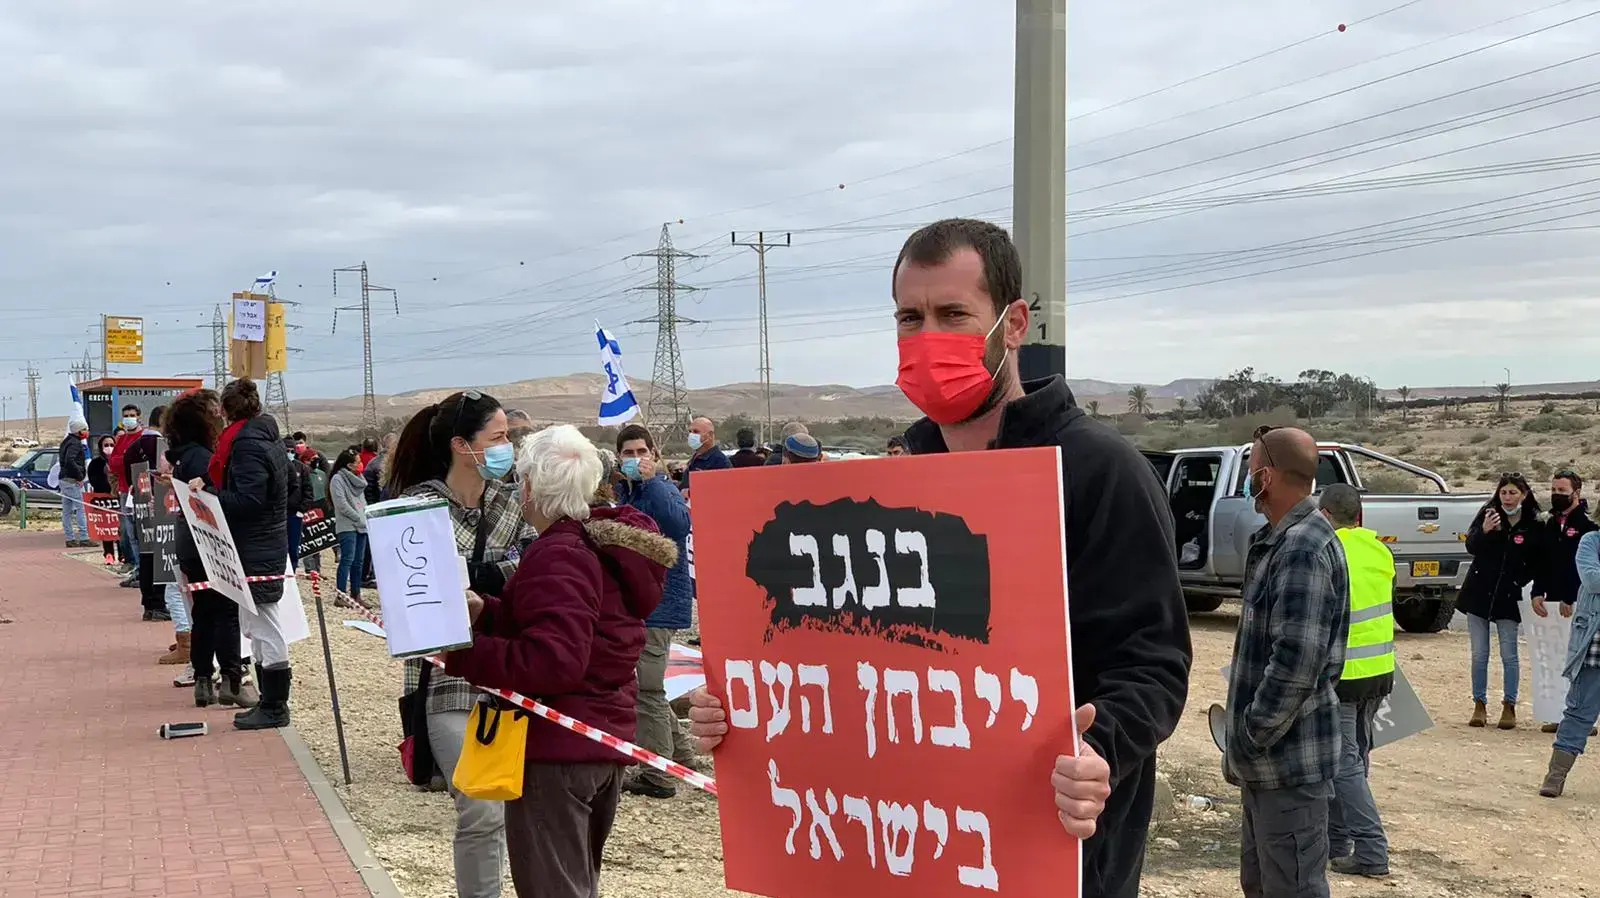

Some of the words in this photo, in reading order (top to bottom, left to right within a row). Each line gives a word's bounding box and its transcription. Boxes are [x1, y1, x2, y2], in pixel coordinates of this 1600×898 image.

[1029, 292, 1041, 311] 2
[1037, 323, 1047, 340] 1
[95, 526, 119, 536] שראל
[156, 524, 175, 544] העם
[789, 528, 936, 611] בנגב
[725, 658, 834, 742] העם
[857, 660, 1039, 759] ייבחן
[767, 758, 999, 892] בישראל
